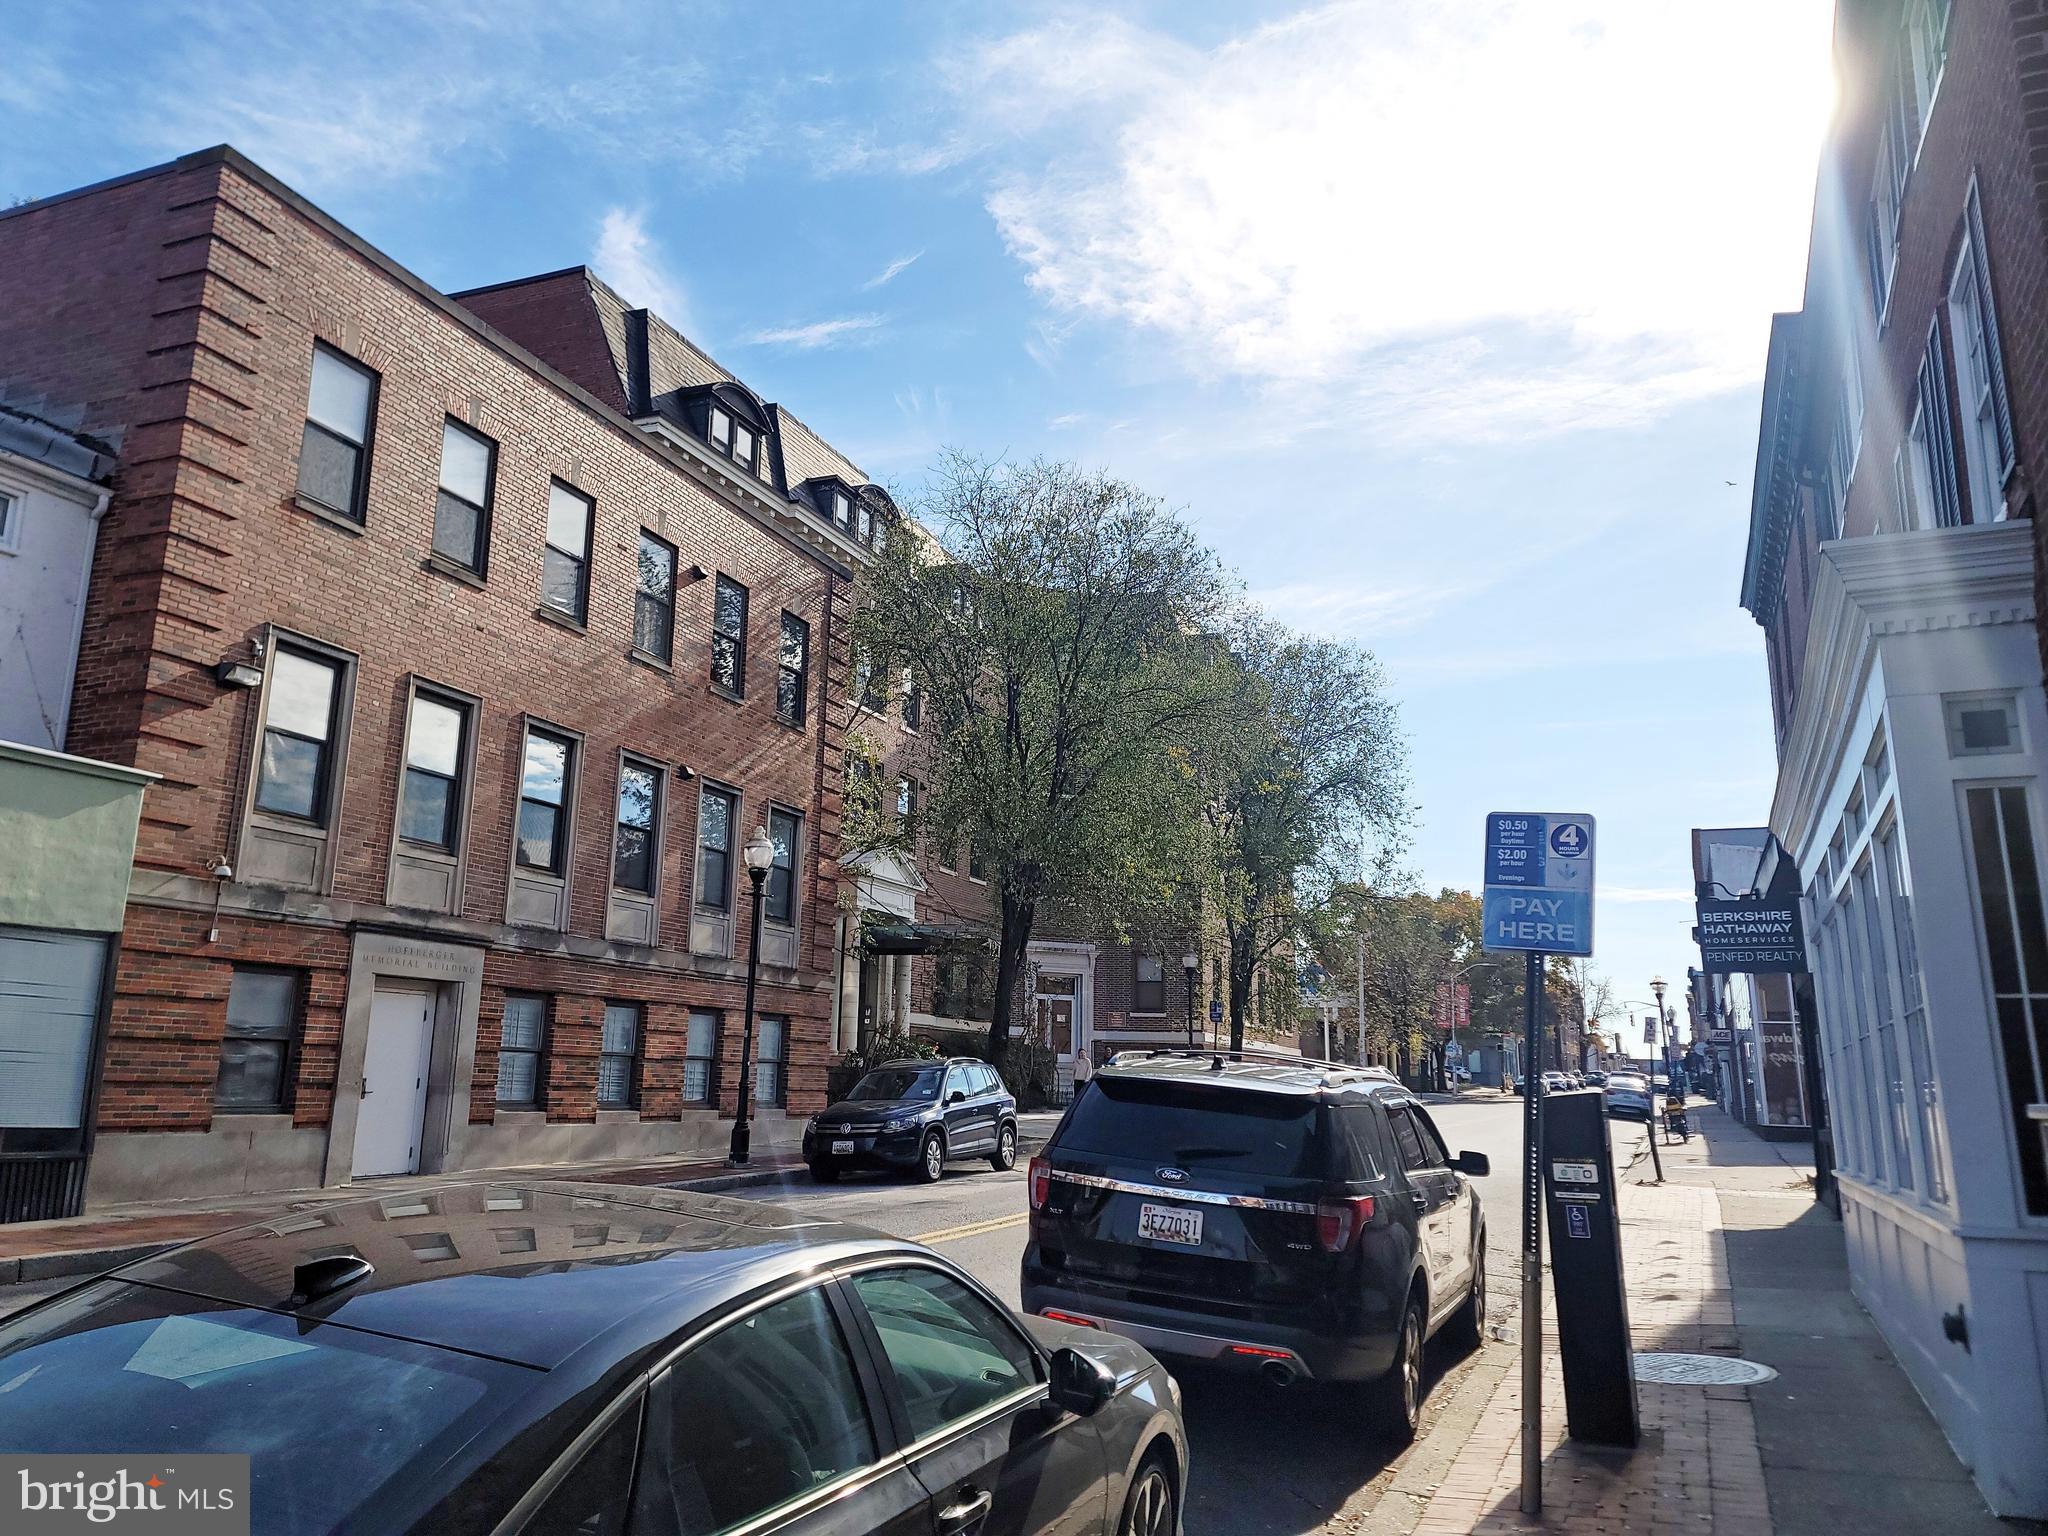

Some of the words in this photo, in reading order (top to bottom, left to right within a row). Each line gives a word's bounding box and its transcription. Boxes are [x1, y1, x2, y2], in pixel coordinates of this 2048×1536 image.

[1498, 820, 1528, 831] $0.50
[1559, 825, 1580, 846] 4
[1500, 838, 1525, 846] Daytime
[1497, 849, 1527, 860] $2.00
[1498, 874, 1525, 883] Evenings
[1510, 897, 1564, 917] PAY
[1702, 910, 1793, 923] BERKSHIRE
[1499, 920, 1576, 943] HERE
[1703, 923, 1793, 935] HATHAWAY
[1705, 936, 1795, 944] HOMESERVICES
[387, 945, 456, 961] HOFFBERGER
[1707, 951, 1754, 962] PENFED
[1757, 950, 1804, 962] REALTY
[362, 953, 420, 969] MEMORIAL
[427, 961, 476, 975] BUILDING
[1713, 1031, 1731, 1039] ACE
[1161, 1169, 1182, 1180] Ford
[1142, 1213, 1198, 1237] 3EZ7031
[1287, 1242, 1313, 1250] 4WD
